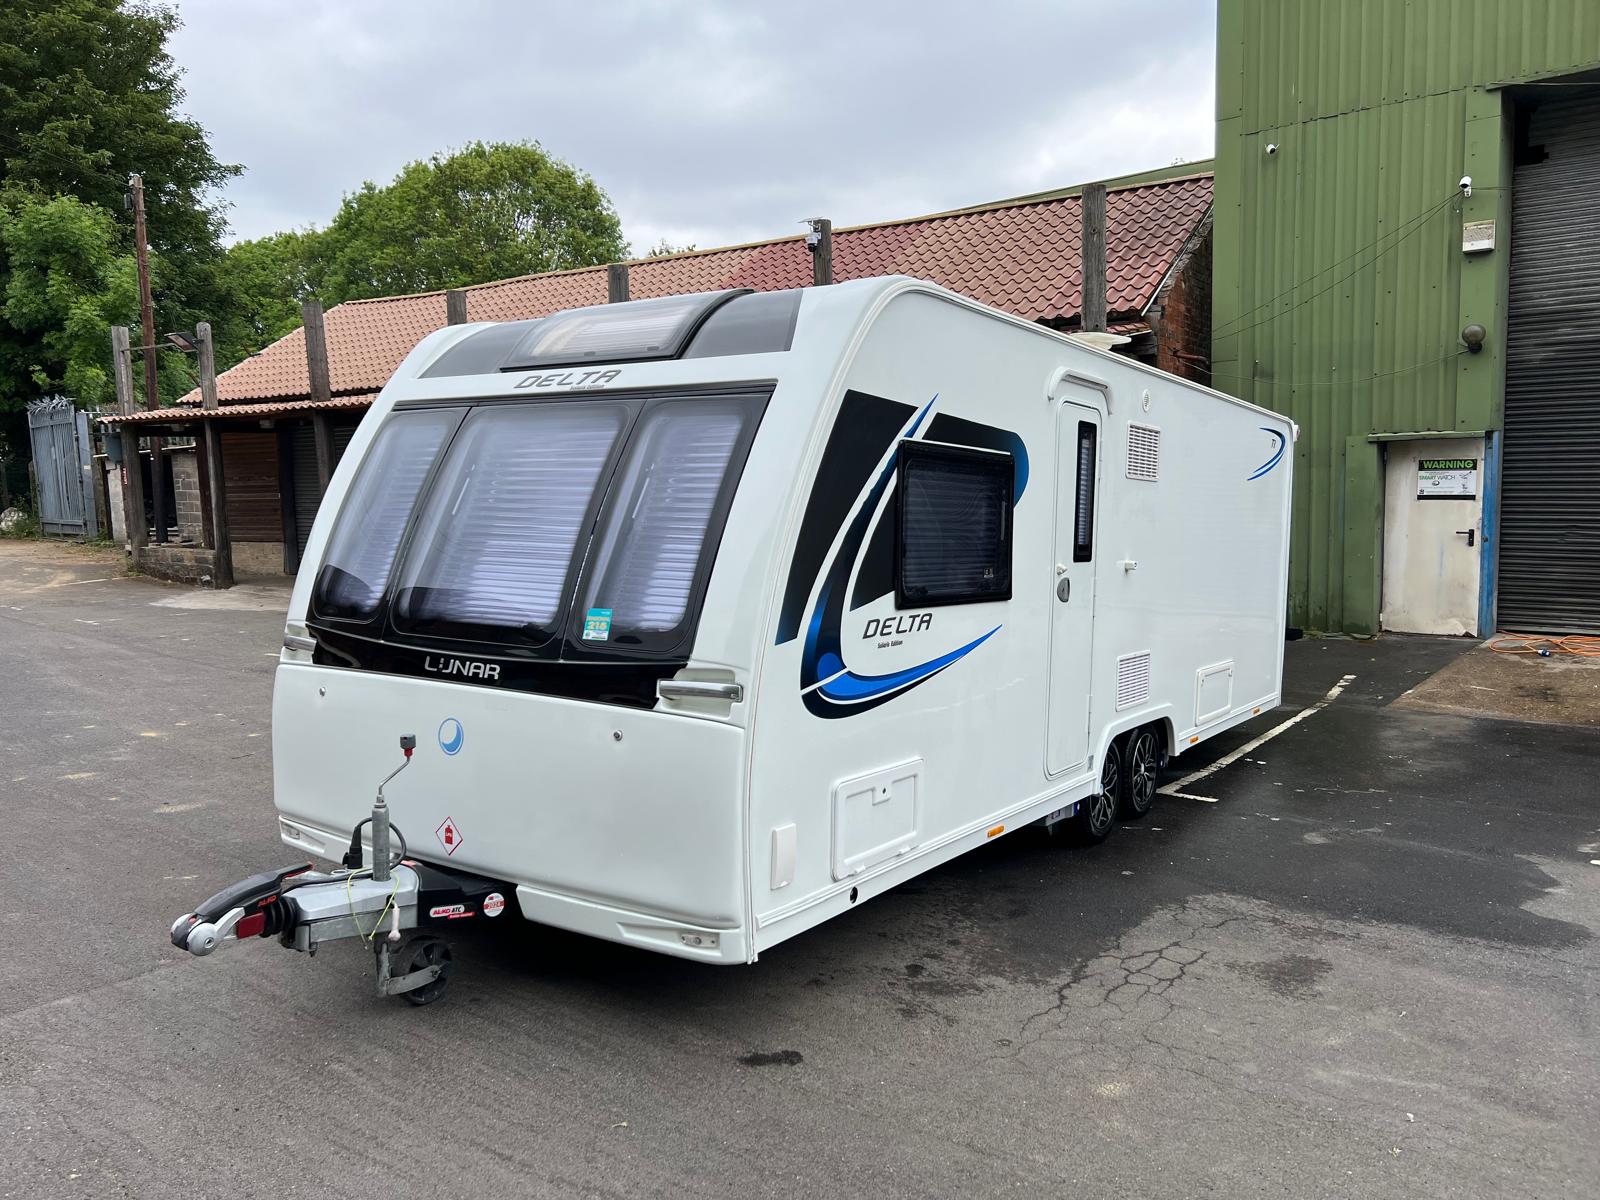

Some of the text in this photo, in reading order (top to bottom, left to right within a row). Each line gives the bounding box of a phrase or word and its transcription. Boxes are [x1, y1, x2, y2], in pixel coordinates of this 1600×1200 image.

[513, 369, 622, 389] DELTA
[1423, 460, 1474, 469] WARNING
[862, 613, 932, 639] DELTA
[424, 655, 501, 680] LUNAR
